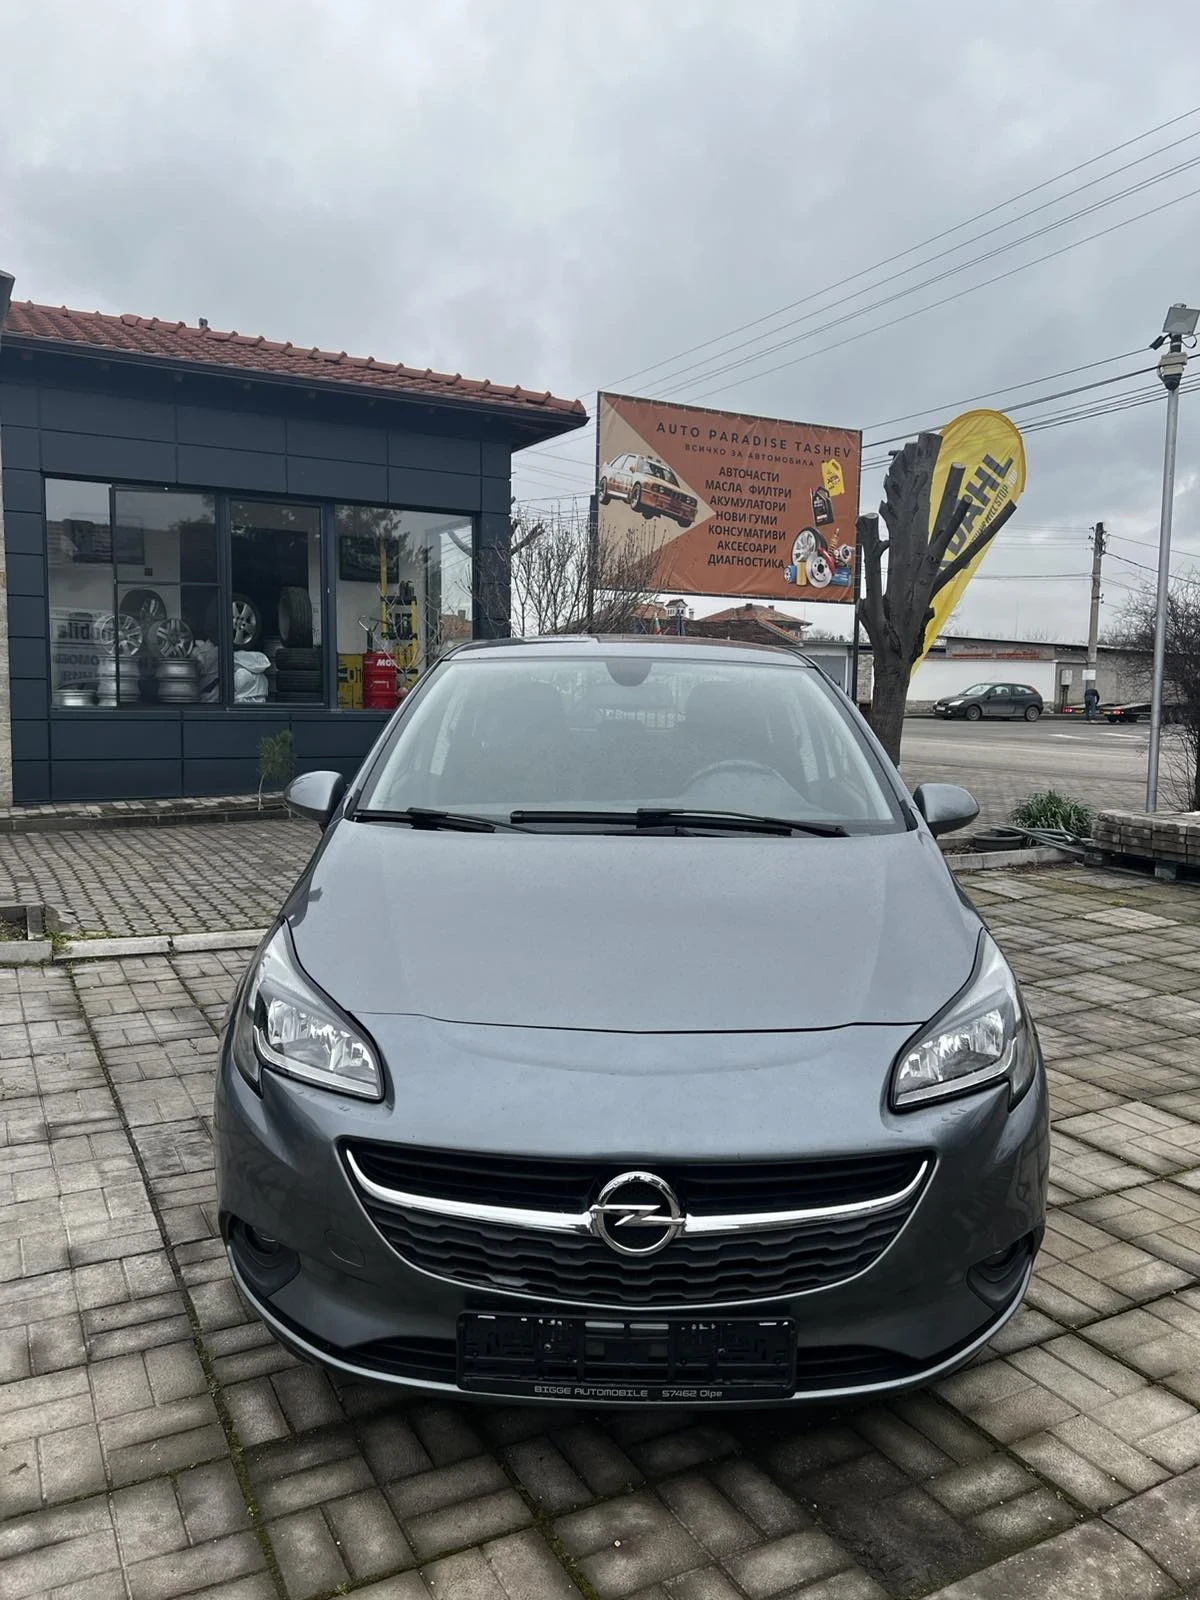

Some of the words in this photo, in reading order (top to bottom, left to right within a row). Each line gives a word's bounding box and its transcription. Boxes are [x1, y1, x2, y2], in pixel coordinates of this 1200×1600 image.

[656, 422, 700, 438] AUTO
[709, 429, 787, 450] PARADISE
[794, 441, 851, 459] TASHEV
[731, 449, 743, 458] ЗА
[748, 452, 815, 467] АВТОМОБИЛА
[719, 466, 780, 482] АВТОЧАСТИ
[705, 480, 742, 493] МАСЛА
[749, 484, 792, 498] ФИЛТРИ
[709, 495, 786, 512] АКУМУЛАТОРИ
[716, 510, 746, 523] НОВИ
[748, 513, 778, 526] ГУМИ
[708, 524, 786, 541] КОНСУМАТИВИ
[717, 540, 777, 554] АКСЕСОАРИ
[707, 554, 785, 569] ДИАГНОСТИКА
[534, 1385, 572, 1395] BIGGE
[574, 1386, 649, 1397] AUTOMOBILE
[661, 1389, 697, 1398] 57462
[699, 1389, 723, 1399] Olpe
